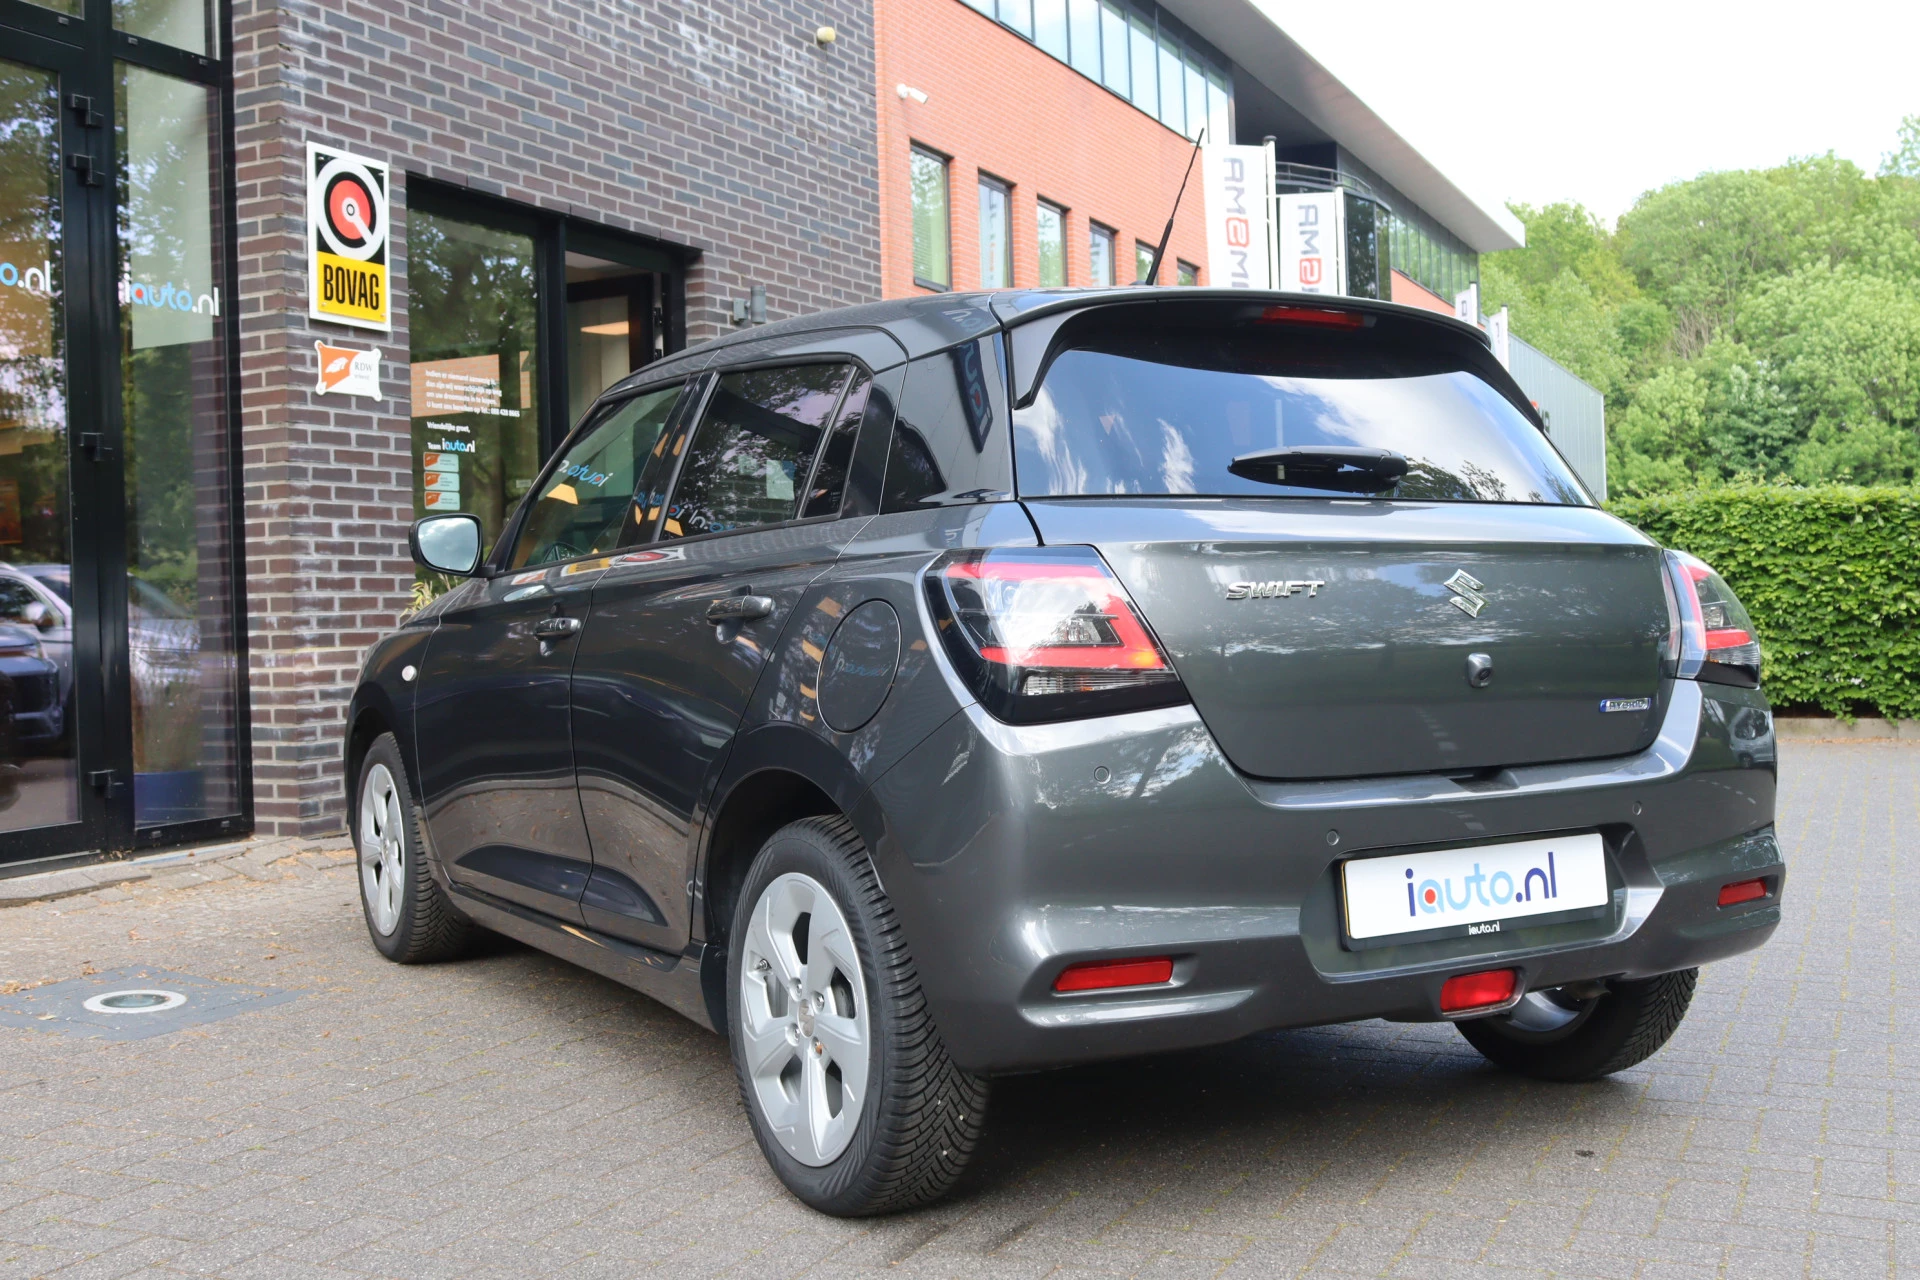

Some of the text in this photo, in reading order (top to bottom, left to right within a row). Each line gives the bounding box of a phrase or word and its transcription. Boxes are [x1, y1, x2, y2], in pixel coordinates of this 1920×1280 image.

[0, 260, 51, 293] o.nl
[323, 264, 380, 311] BOVAG
[124, 272, 220, 317] iauto.nl
[354, 361, 373, 372] RDW
[442, 437, 476, 453] iauto.nl
[1226, 580, 1325, 600] SWIFT
[1405, 851, 1557, 917] iauto.nl
[1468, 921, 1500, 936] iauto.nl
